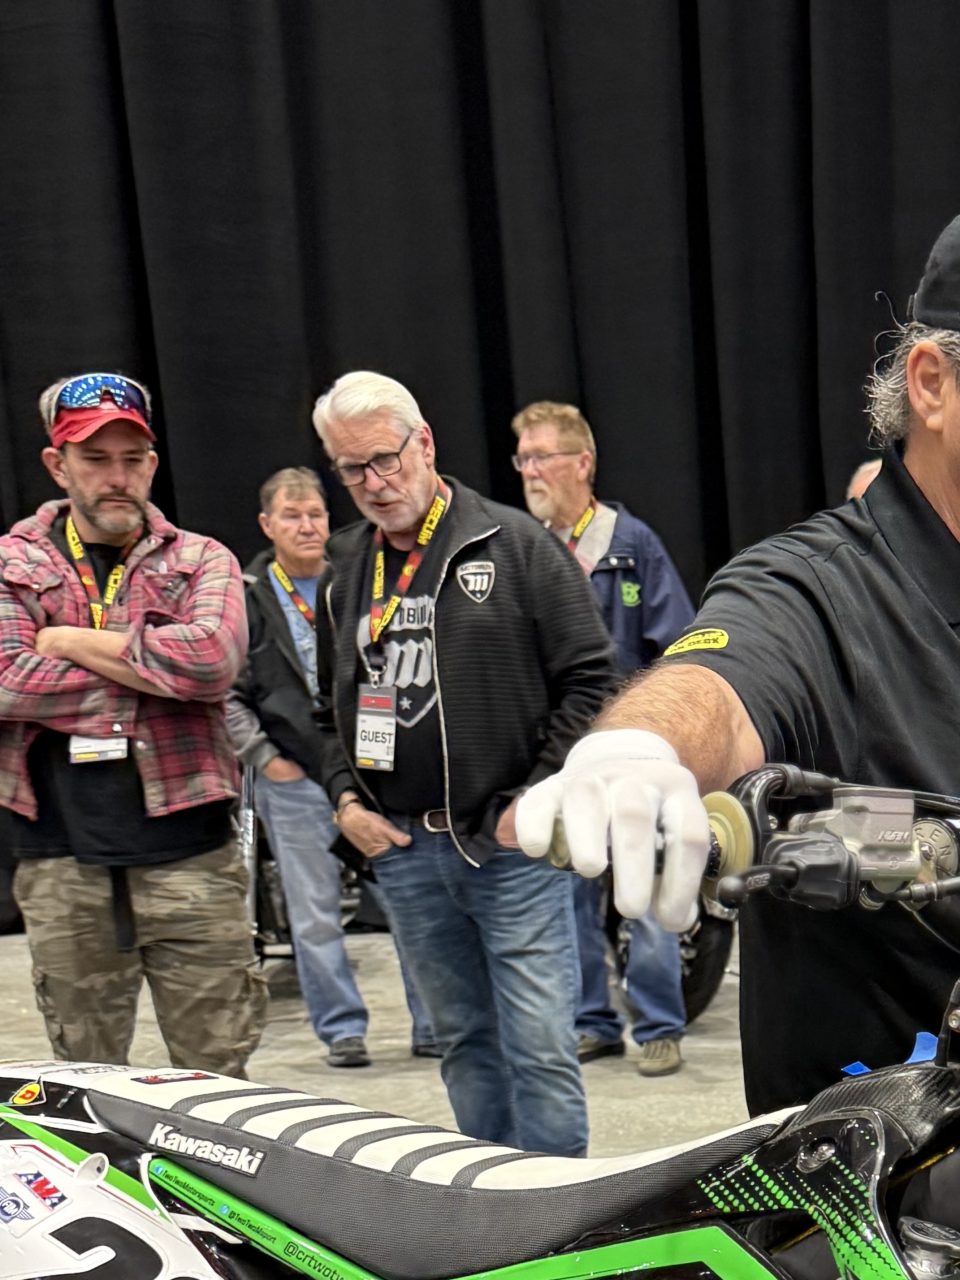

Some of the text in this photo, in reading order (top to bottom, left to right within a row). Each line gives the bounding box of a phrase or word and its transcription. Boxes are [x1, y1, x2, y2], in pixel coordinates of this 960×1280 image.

[418, 495, 447, 546] MECUM
[360, 730, 392, 744] GUEST
[149, 1122, 264, 1175] Kawasaki
